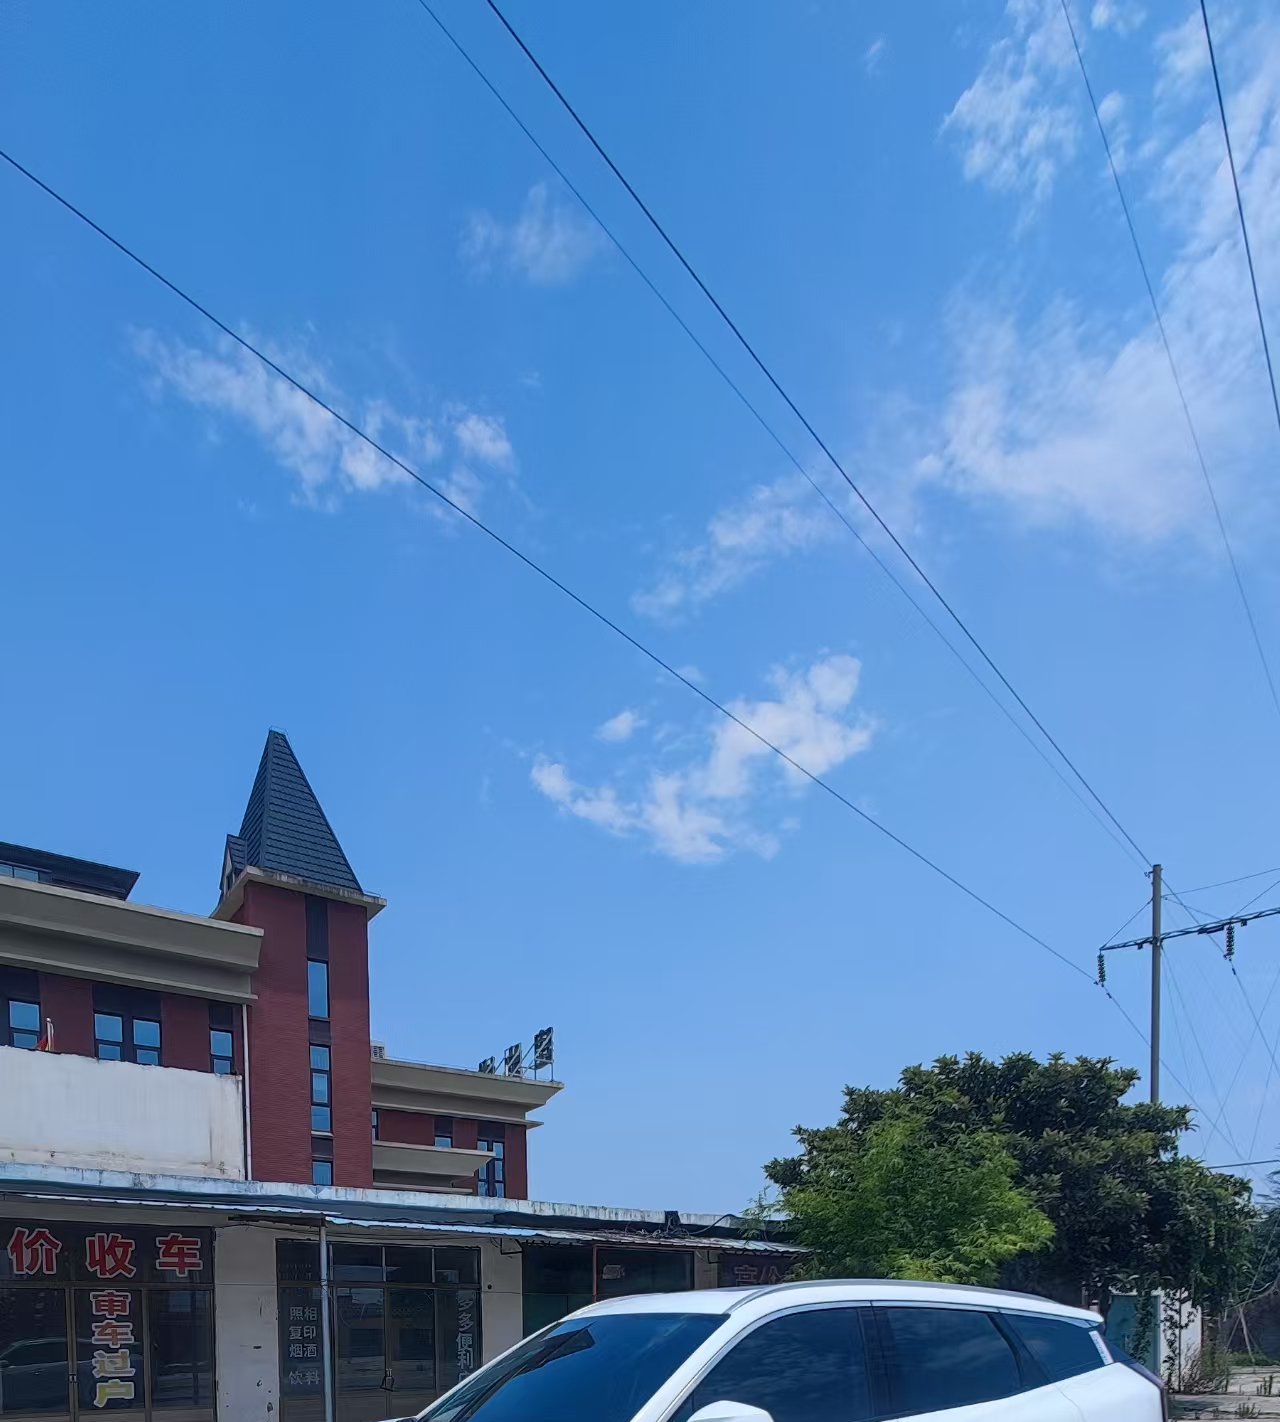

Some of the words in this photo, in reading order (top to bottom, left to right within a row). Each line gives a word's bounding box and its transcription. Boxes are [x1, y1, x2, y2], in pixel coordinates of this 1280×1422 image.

[8, 1227, 203, 1278] 价收车
[289, 1306, 318, 1321] 照相
[288, 1325, 316, 1339] 复印
[90, 1290, 136, 1408] 审车过户
[289, 1343, 318, 1358] 烟酒
[288, 1369, 321, 1385] 饮料
